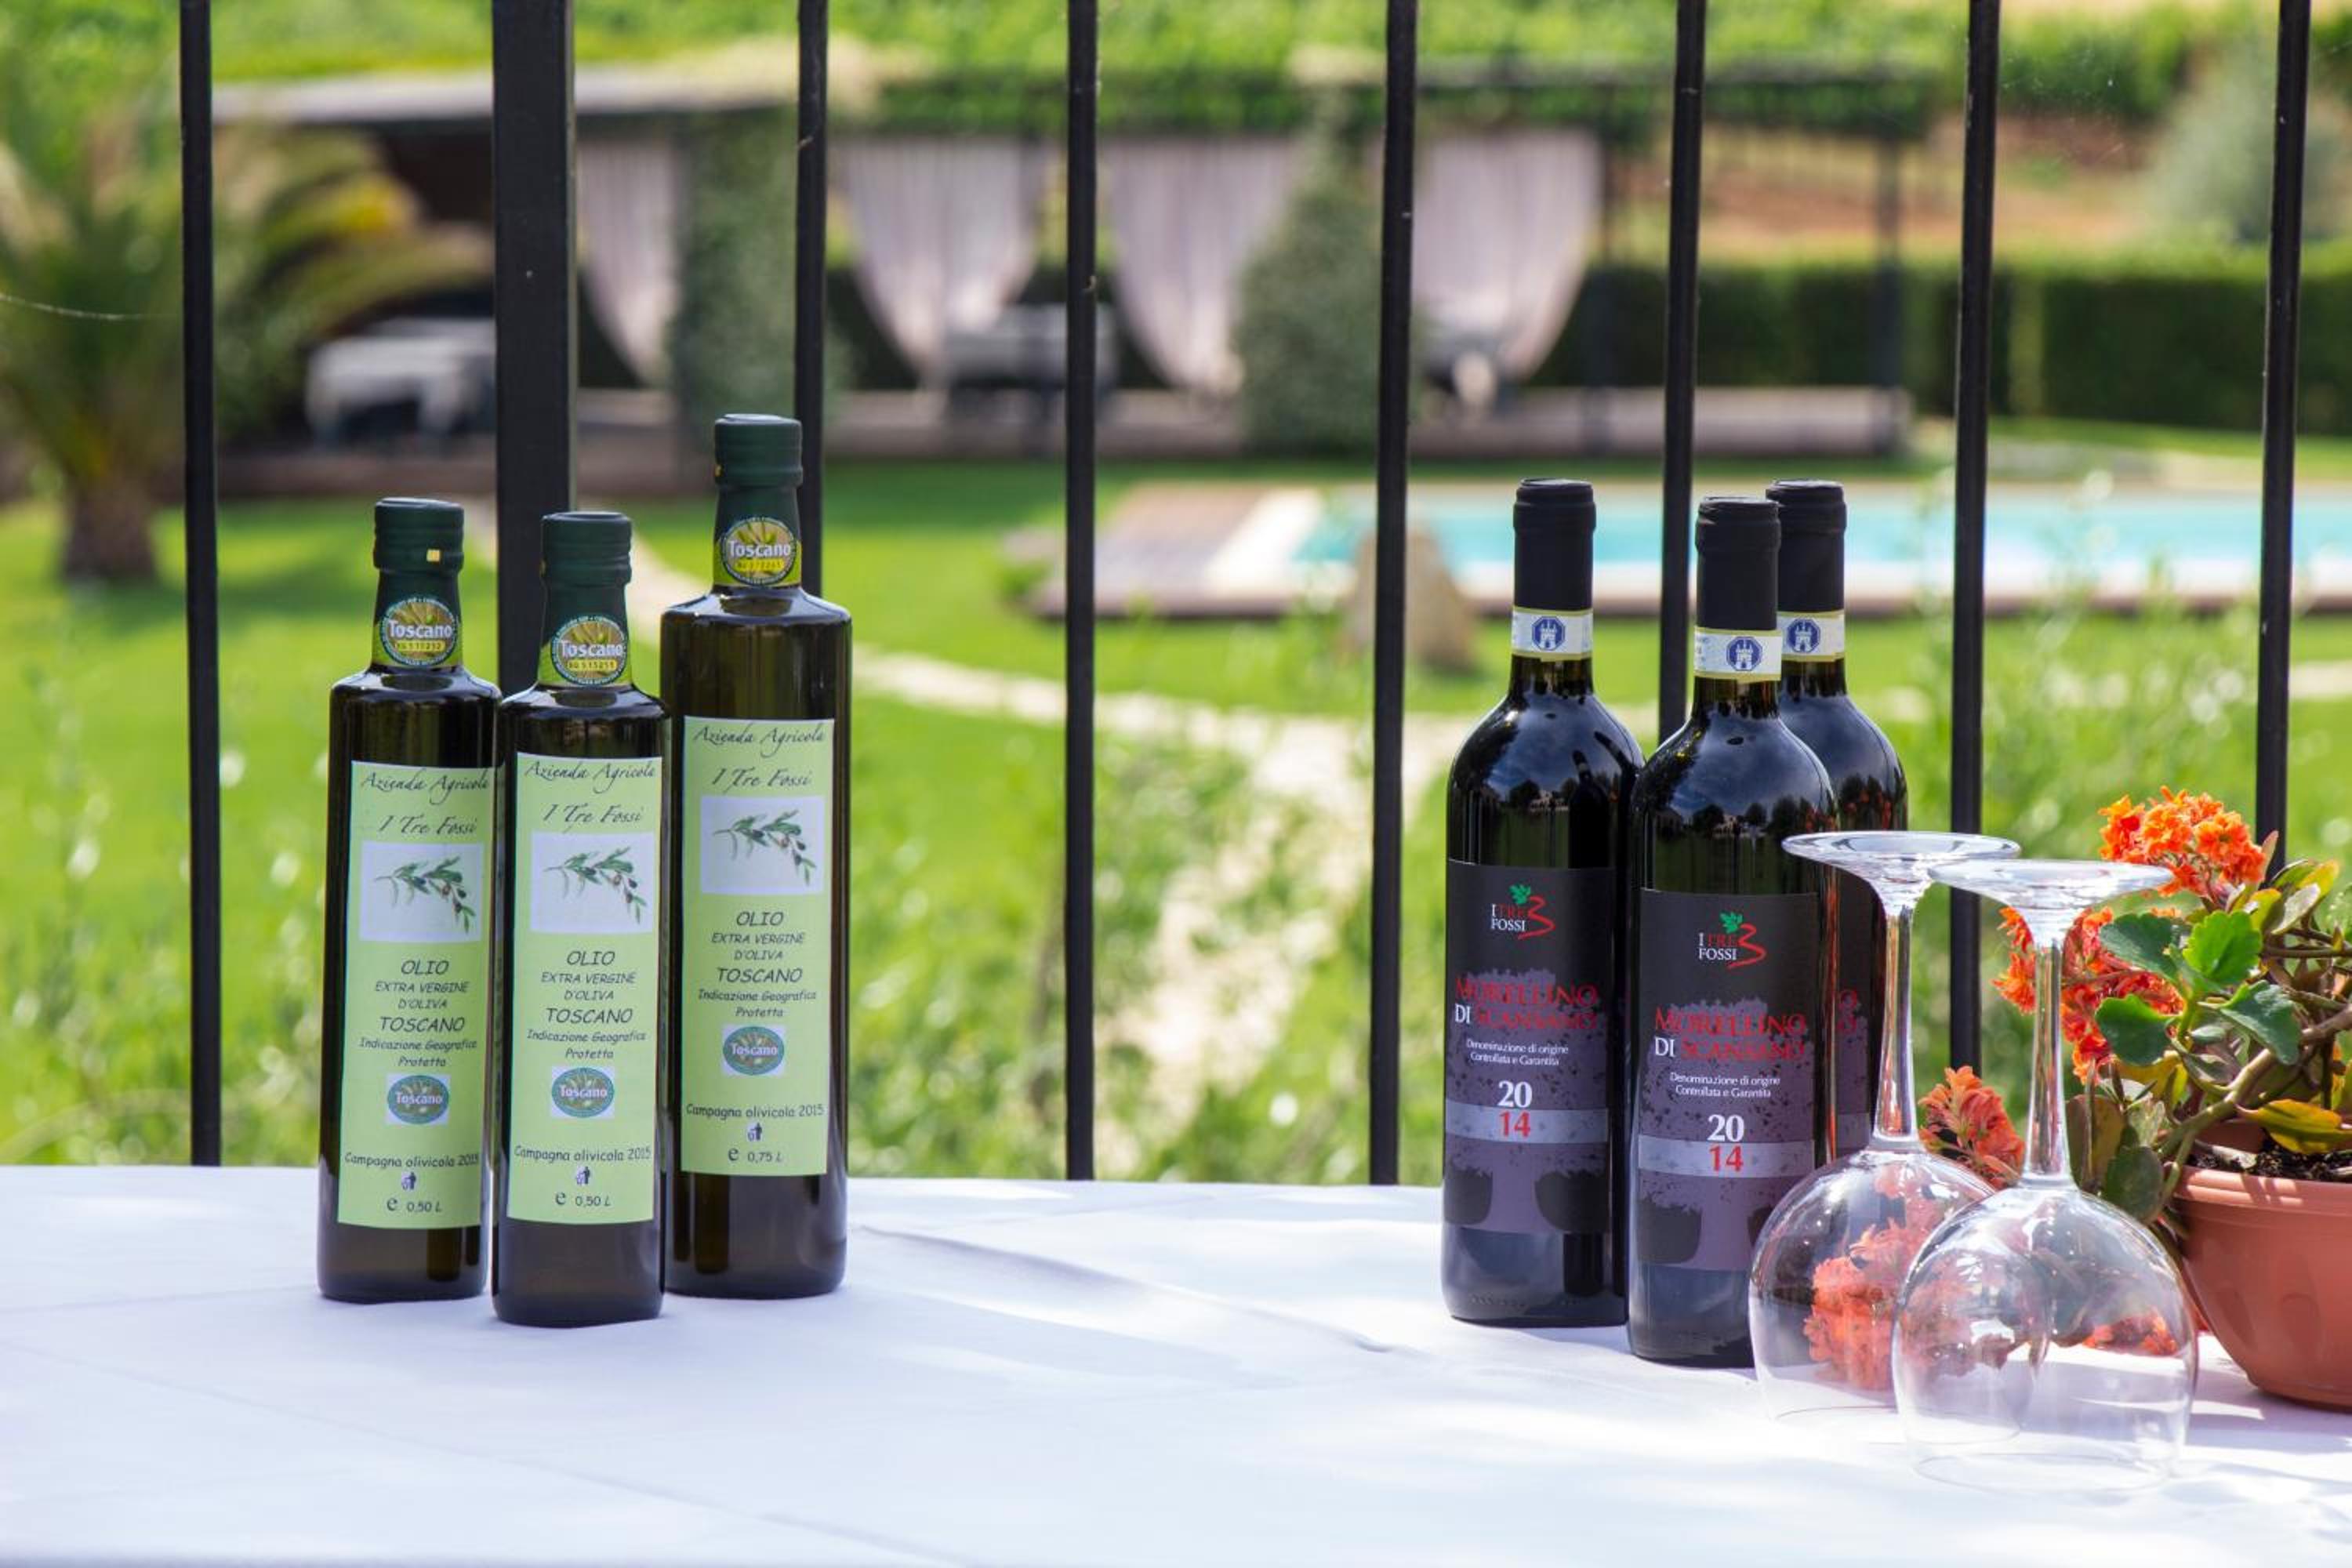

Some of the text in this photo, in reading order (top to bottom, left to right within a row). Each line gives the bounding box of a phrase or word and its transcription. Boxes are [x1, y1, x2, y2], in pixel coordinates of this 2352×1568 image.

[728, 539, 792, 557] Toscano
[388, 619, 453, 639] Toscano
[561, 639, 624, 658] Toscano
[693, 720, 826, 758] Azienda Agricola
[524, 760, 655, 795] Azienda Agricola
[723, 766, 760, 795] Tre
[767, 768, 813, 787] Fossi
[363, 768, 489, 806] Azienda Agricola
[399, 814, 430, 835] Tre
[435, 815, 477, 835] Fossi
[561, 803, 593, 833] Tre
[601, 804, 644, 823] Fossi
[736, 911, 784, 927] OLIO
[1490, 917, 1526, 933] FOSSI
[711, 932, 806, 944] EXTRA VERGINE
[566, 950, 615, 966] OLIO
[733, 949, 784, 961] D'OLIVA
[1698, 947, 1737, 961] FOSSI
[401, 960, 449, 975] OLIO
[717, 967, 804, 983] TOSCANO
[541, 971, 637, 984] EXTRA VERGINE
[374, 981, 470, 993] EXTRA VERGINE
[564, 989, 615, 1000] D'OLIVA
[697, 989, 760, 1001] Indicazione
[397, 998, 448, 1010] D'OLIVA
[735, 1006, 784, 1018] Protetta
[546, 1007, 633, 1024] TOSCANO
[1454, 1003, 1472, 1025] DI
[379, 1017, 466, 1033] TOSCANO
[358, 1037, 423, 1051] Indicazione
[526, 1029, 588, 1043] Indicazione
[564, 1047, 615, 1059] Protetta
[730, 1043, 779, 1056] Toscano
[1653, 1035, 1675, 1058] DI
[397, 1056, 447, 1068] Protetta
[1669, 1072, 1781, 1087] Denominazione di origine
[395, 1091, 444, 1105] Toscano
[558, 1084, 608, 1098] Toscano
[1497, 1080, 1533, 1109] 20
[1675, 1084, 1722, 1097] Controllata
[1730, 1087, 1772, 1098] Garantita
[685, 1102, 742, 1121] Campagna
[745, 1105, 795, 1118] olivicola
[1498, 1110, 1531, 1138] 14
[1707, 1114, 1745, 1142] 20
[344, 1152, 402, 1170] Campagna
[405, 1153, 455, 1167] olivicola
[514, 1144, 571, 1164] Campagna
[573, 1148, 624, 1162] olivicola
[1709, 1144, 1744, 1172] 14
